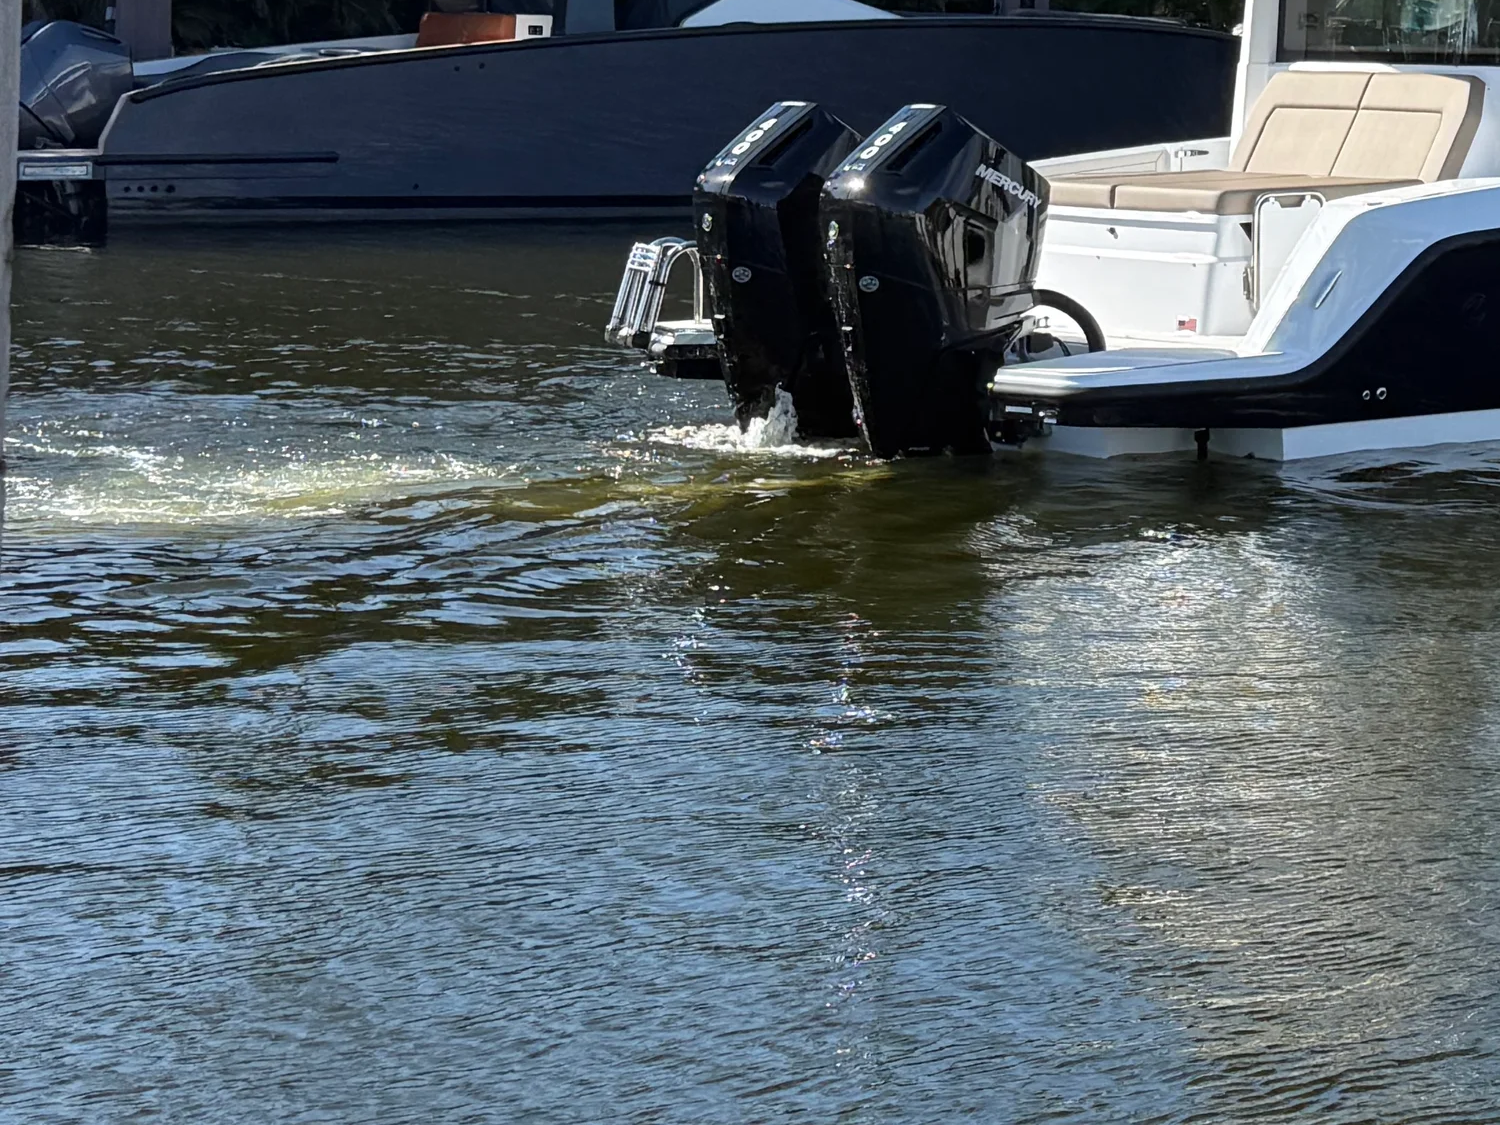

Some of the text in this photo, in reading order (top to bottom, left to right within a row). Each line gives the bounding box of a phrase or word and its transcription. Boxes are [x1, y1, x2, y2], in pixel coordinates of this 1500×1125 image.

[731, 118, 778, 156] 400
[860, 121, 908, 160] 400
[975, 163, 1042, 209] MERCURY
